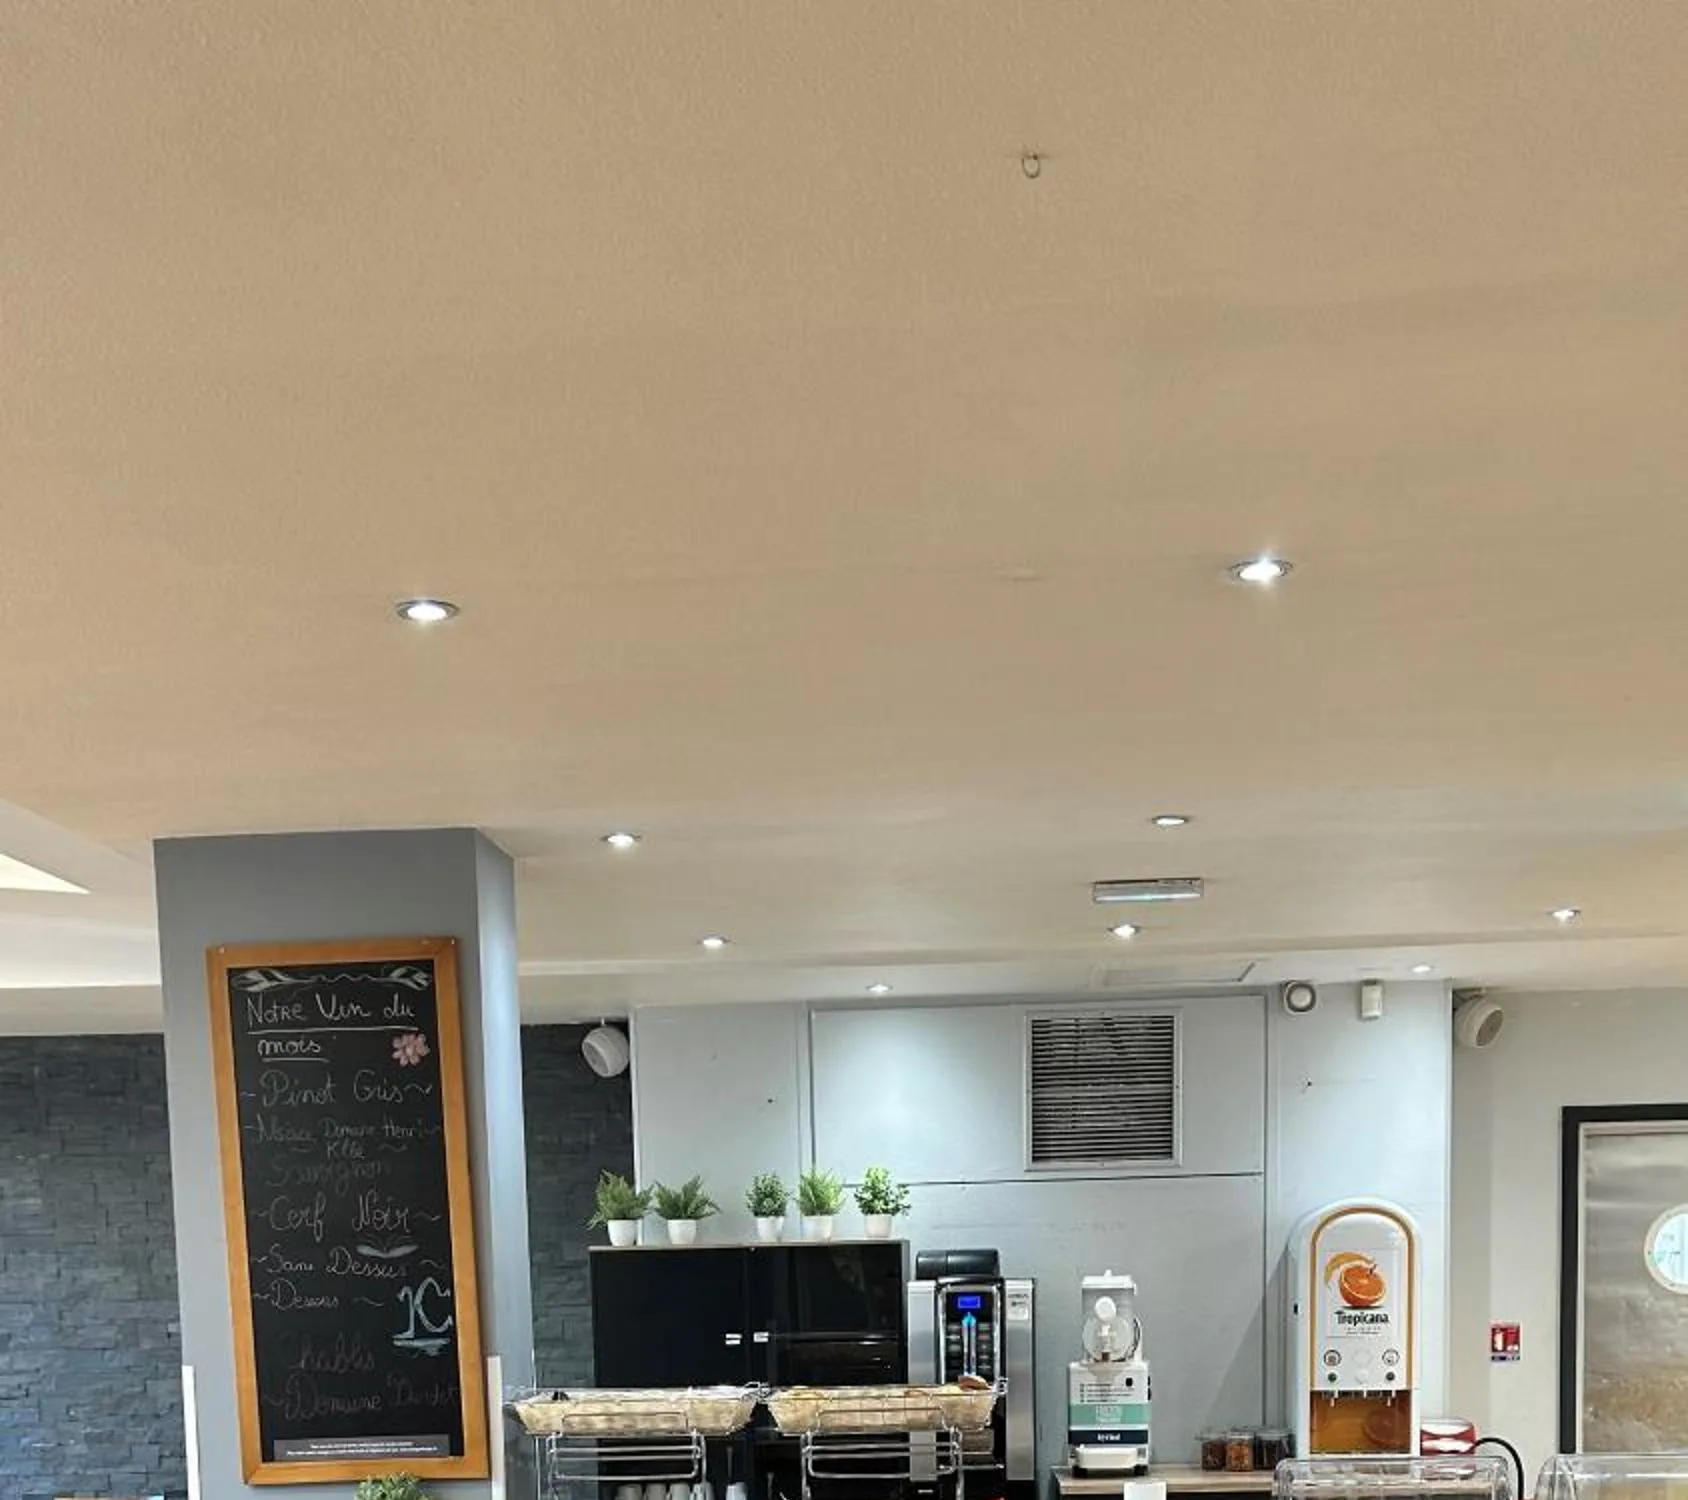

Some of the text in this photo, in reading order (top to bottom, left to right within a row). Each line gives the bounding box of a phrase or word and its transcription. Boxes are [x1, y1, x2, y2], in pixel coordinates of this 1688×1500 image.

[383, 993, 416, 1018] du
[258, 1038, 321, 1056] mois
[259, 1069, 404, 1107] Pinot Gris
[352, 1188, 412, 1233] Noir
[1334, 1310, 1390, 1327] Tropicana
